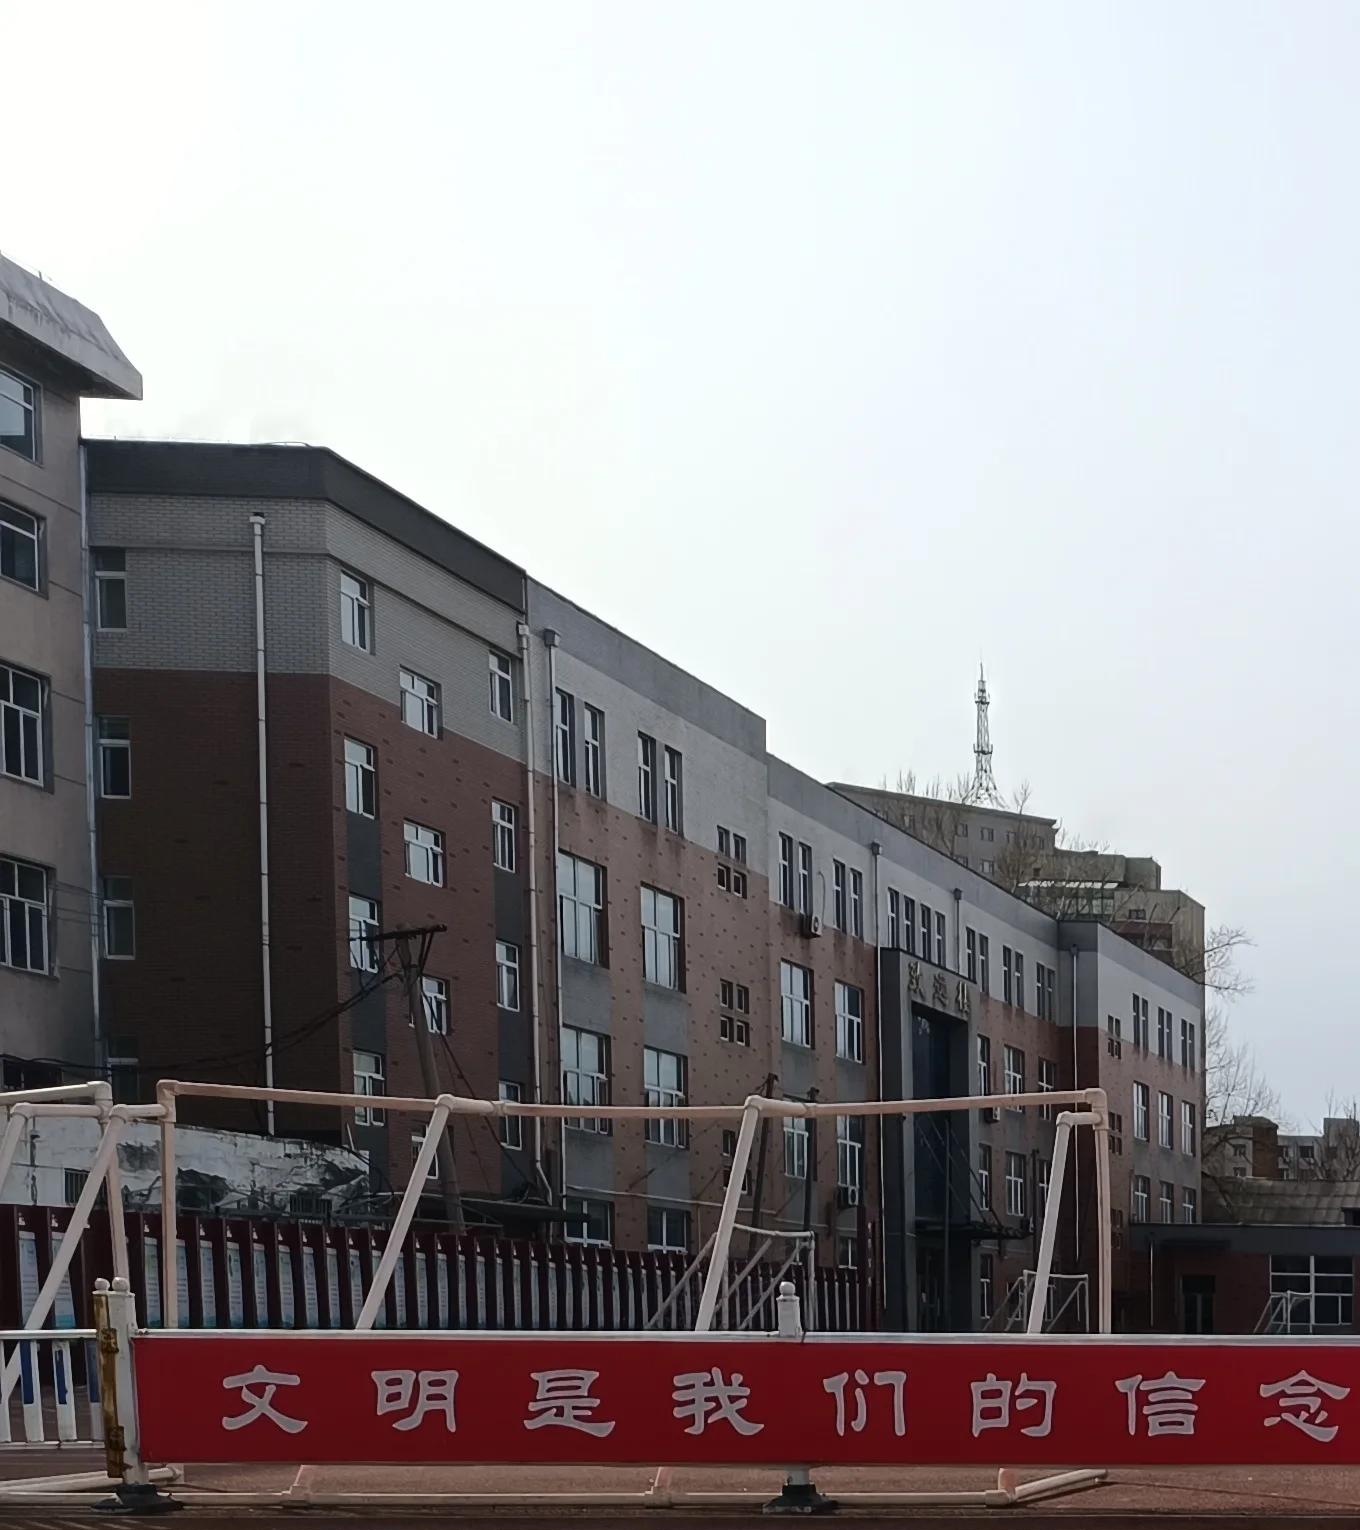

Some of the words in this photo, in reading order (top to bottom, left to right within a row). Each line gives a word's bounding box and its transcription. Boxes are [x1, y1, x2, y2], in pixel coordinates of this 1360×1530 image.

[222, 1363, 1351, 1442] 文明是我们的信念
